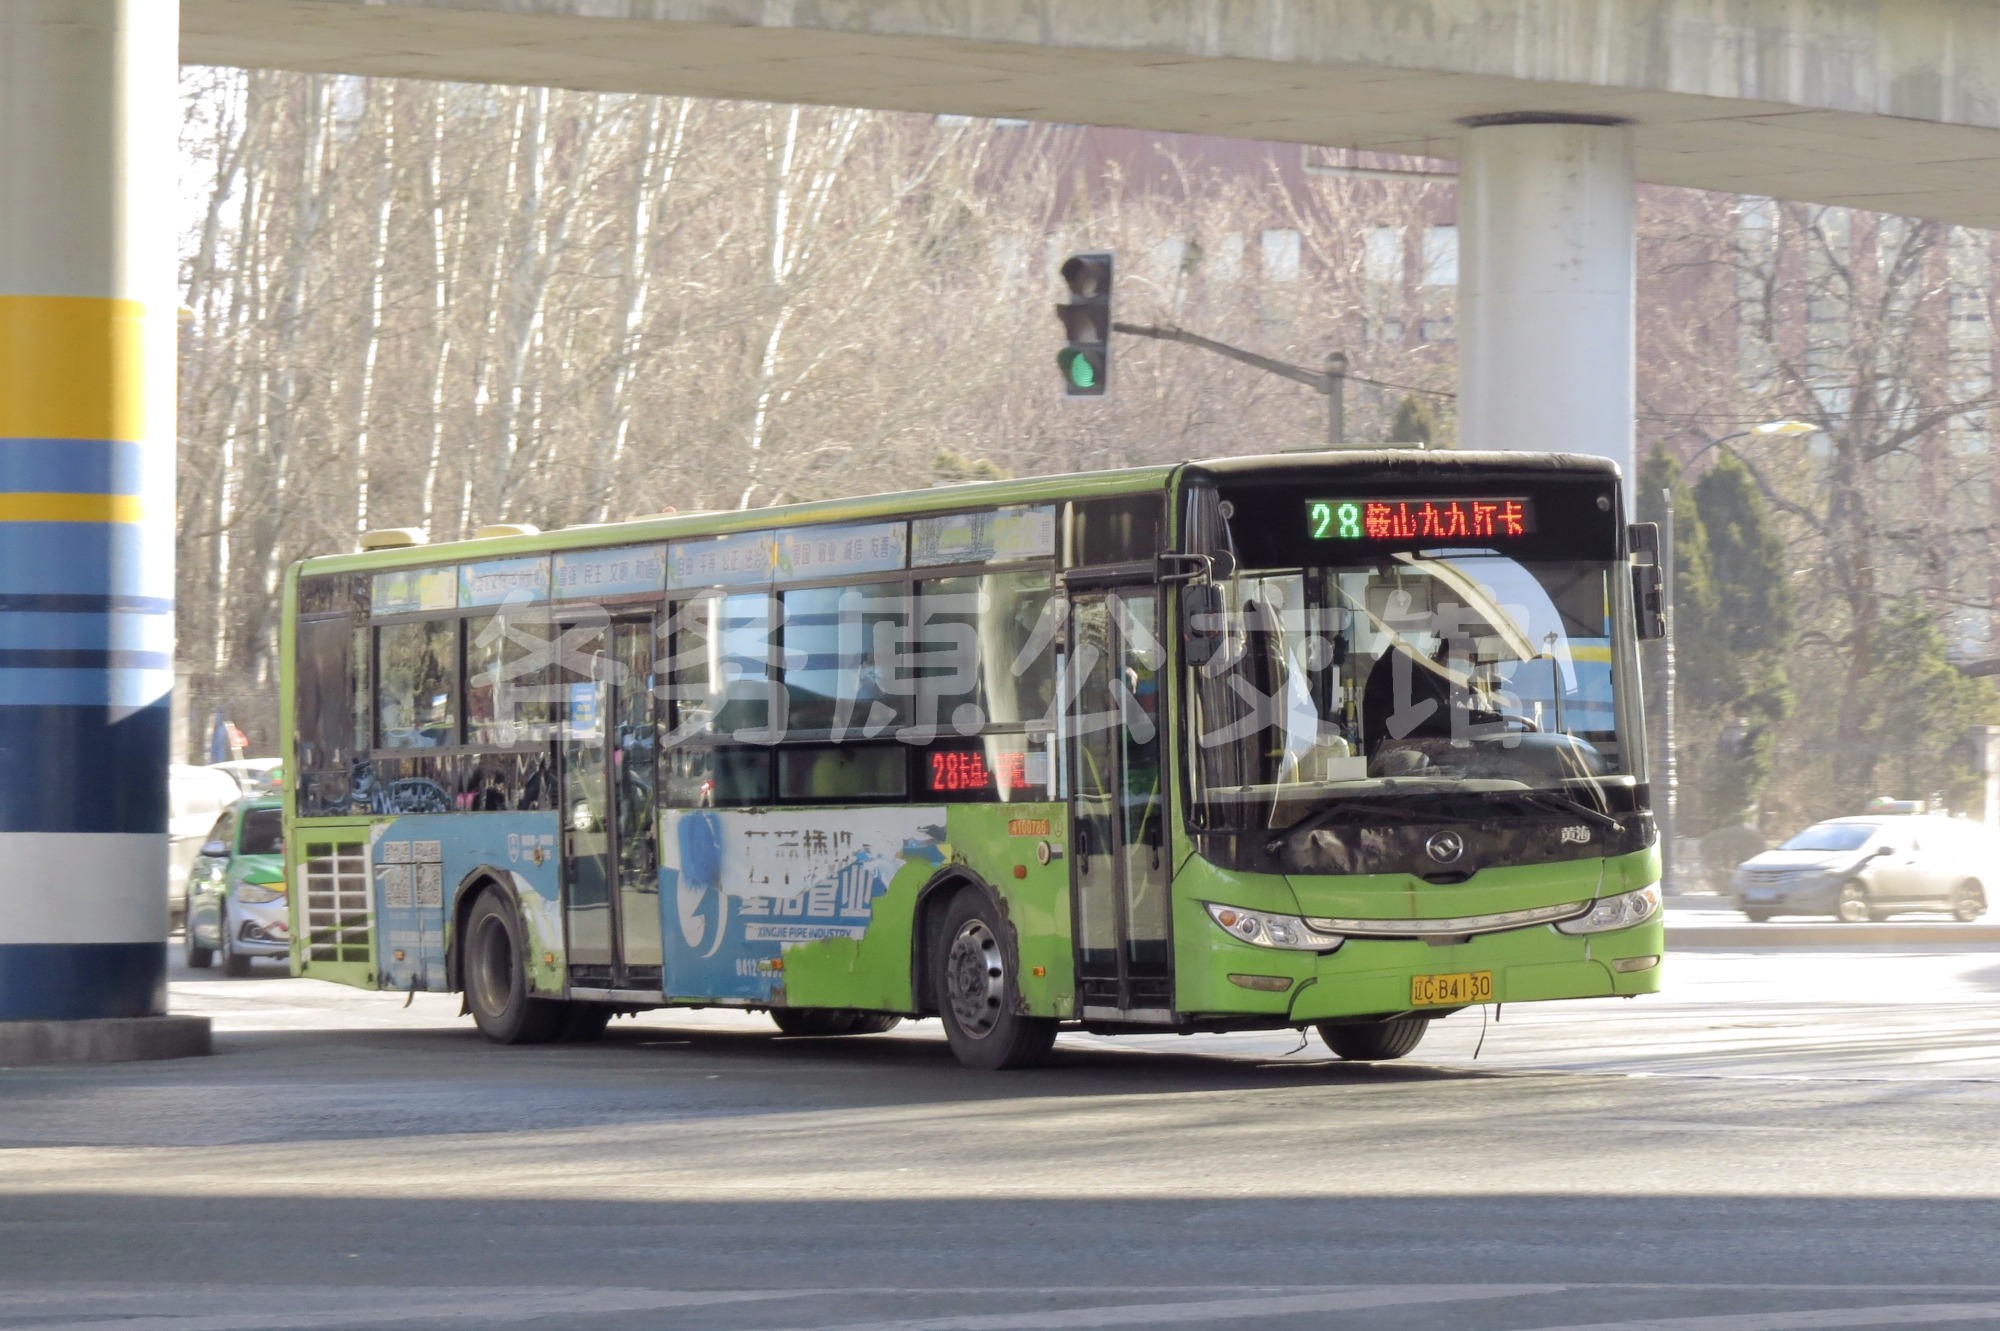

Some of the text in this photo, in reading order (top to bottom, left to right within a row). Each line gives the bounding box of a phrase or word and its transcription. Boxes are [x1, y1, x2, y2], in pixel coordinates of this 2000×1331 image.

[1311, 502, 1523, 537] 28 鞍山九九打卡
[933, 752, 958, 789] 28
[1560, 825, 1590, 843] 黄海
